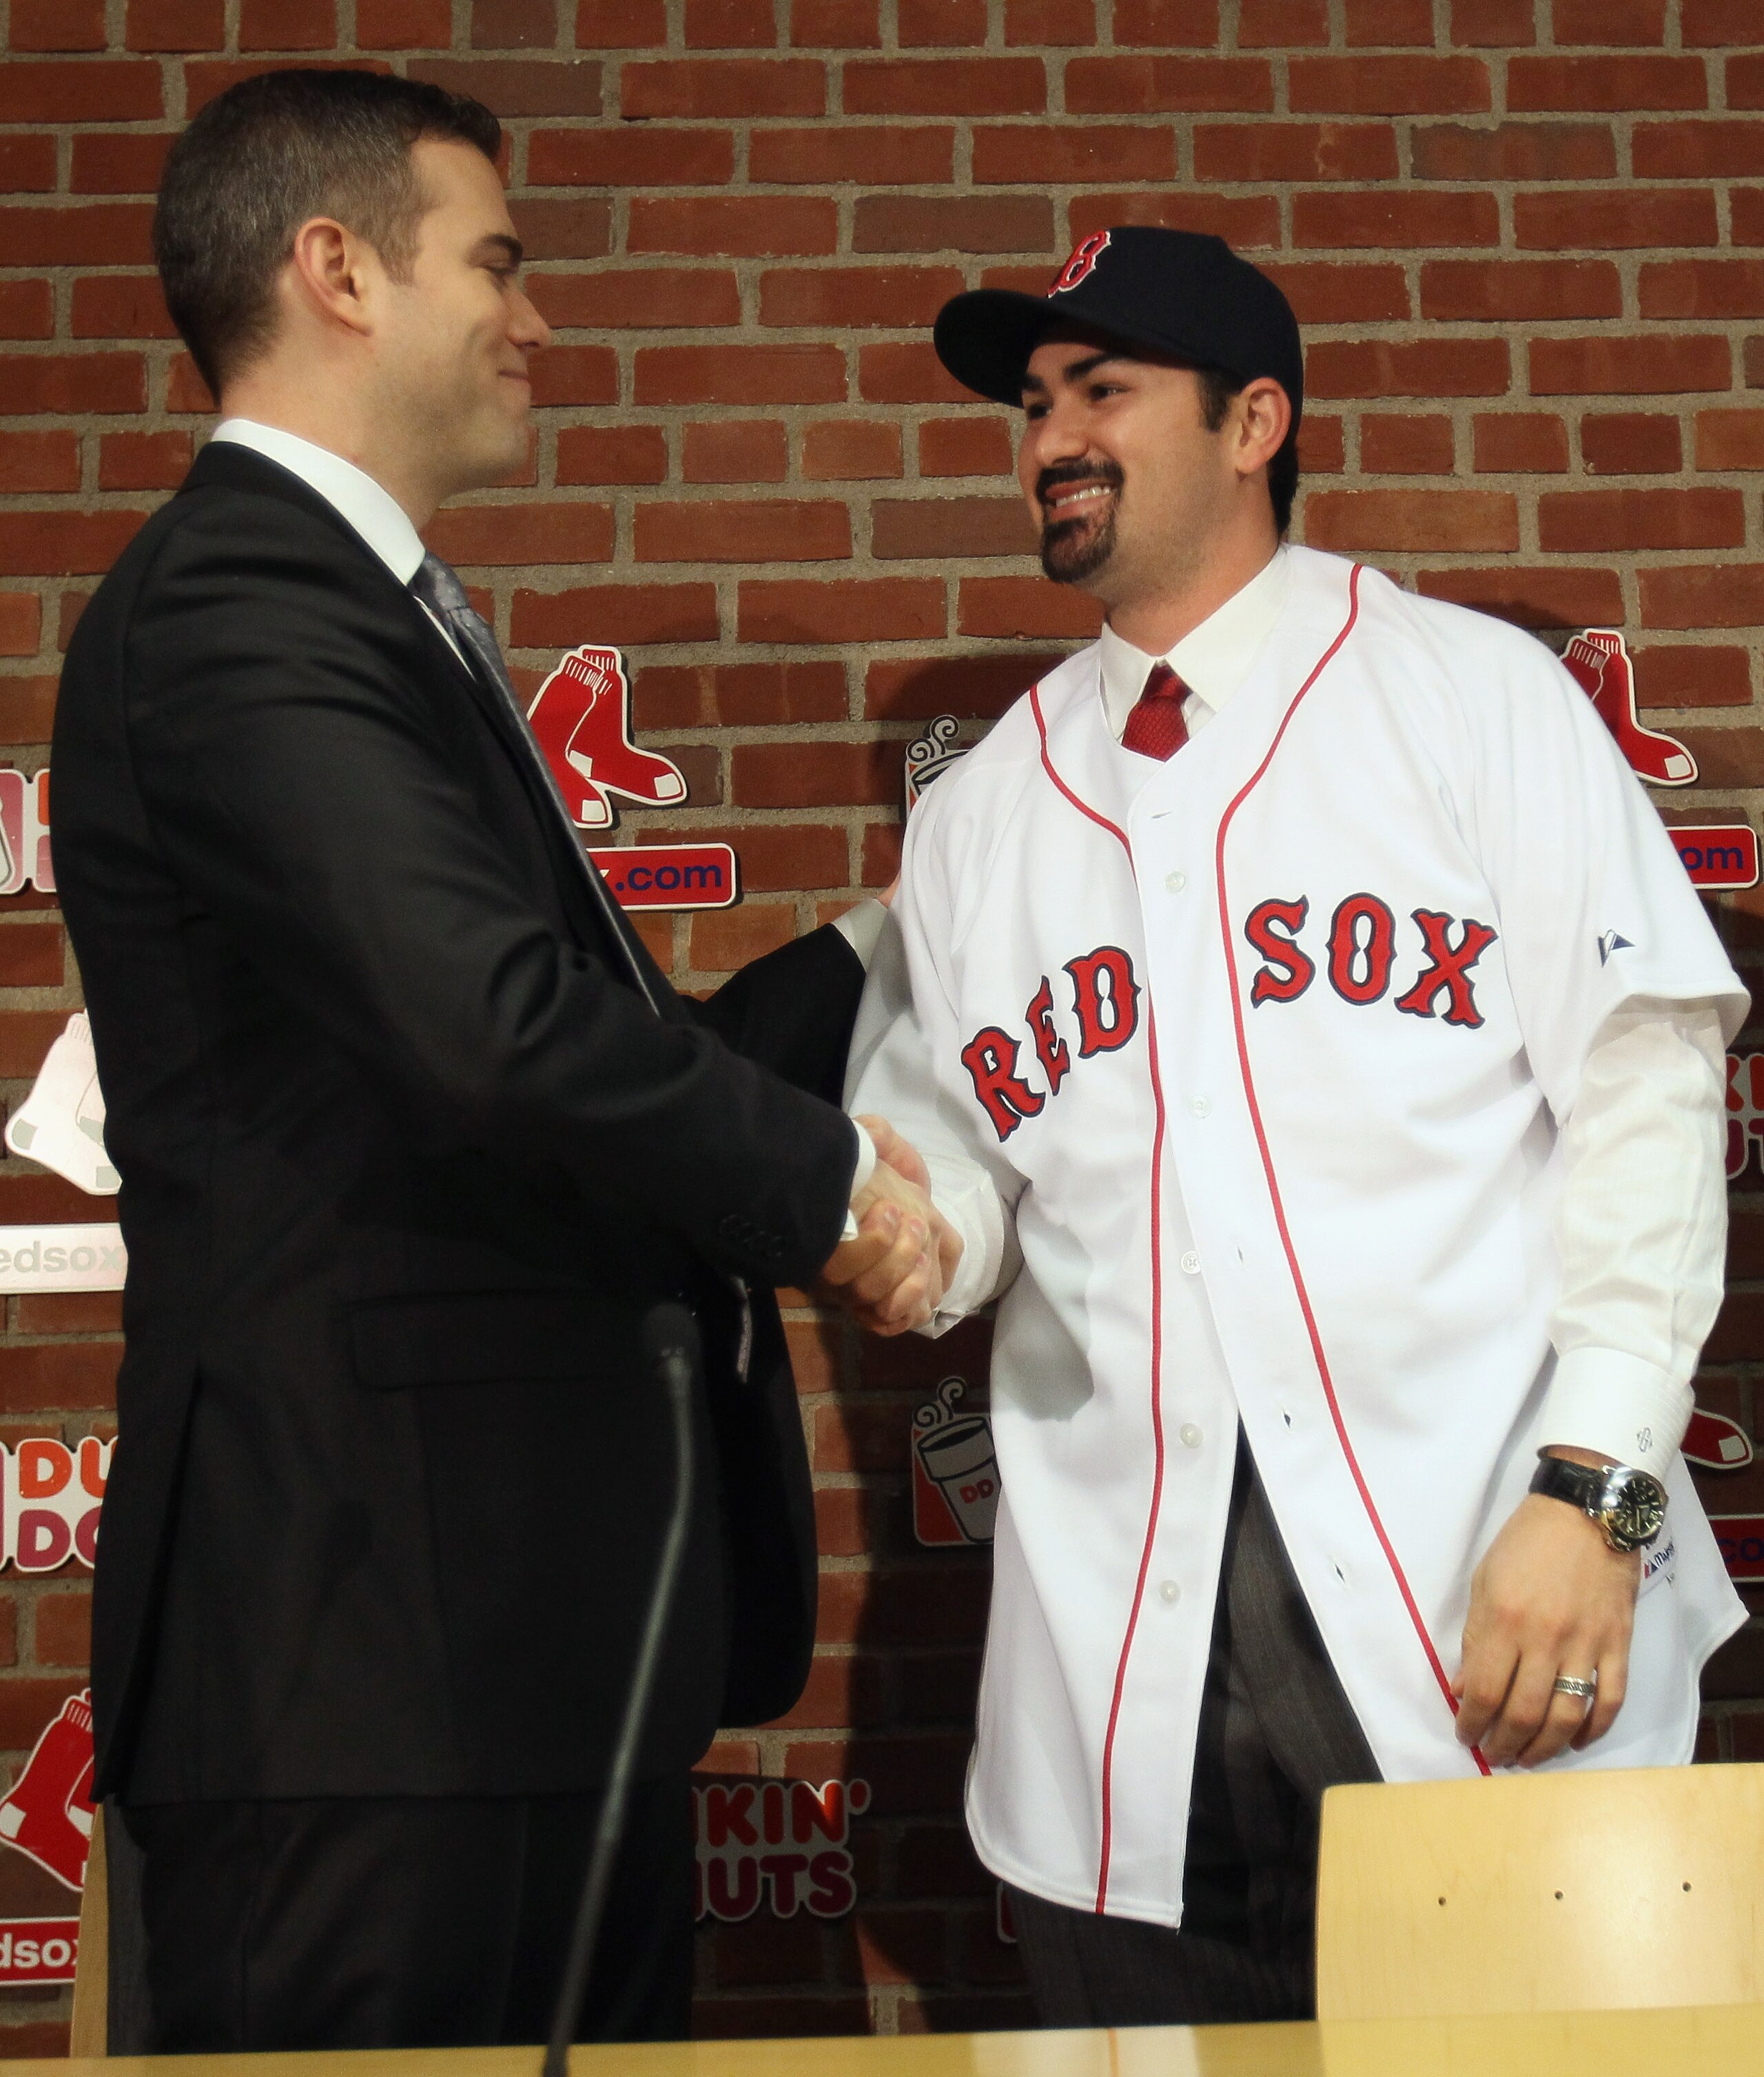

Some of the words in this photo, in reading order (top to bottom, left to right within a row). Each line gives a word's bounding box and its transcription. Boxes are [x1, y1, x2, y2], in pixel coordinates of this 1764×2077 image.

[1047, 229, 1111, 298] B
[599, 863, 722, 891] .com
[961, 945, 1142, 1143] RED
[1244, 892, 1499, 1030] SOX
[960, 1479, 994, 1504] DD
[692, 1781, 868, 1848] KIN'
[694, 1851, 853, 1918] UTS
[0, 1932, 79, 1969] dso
